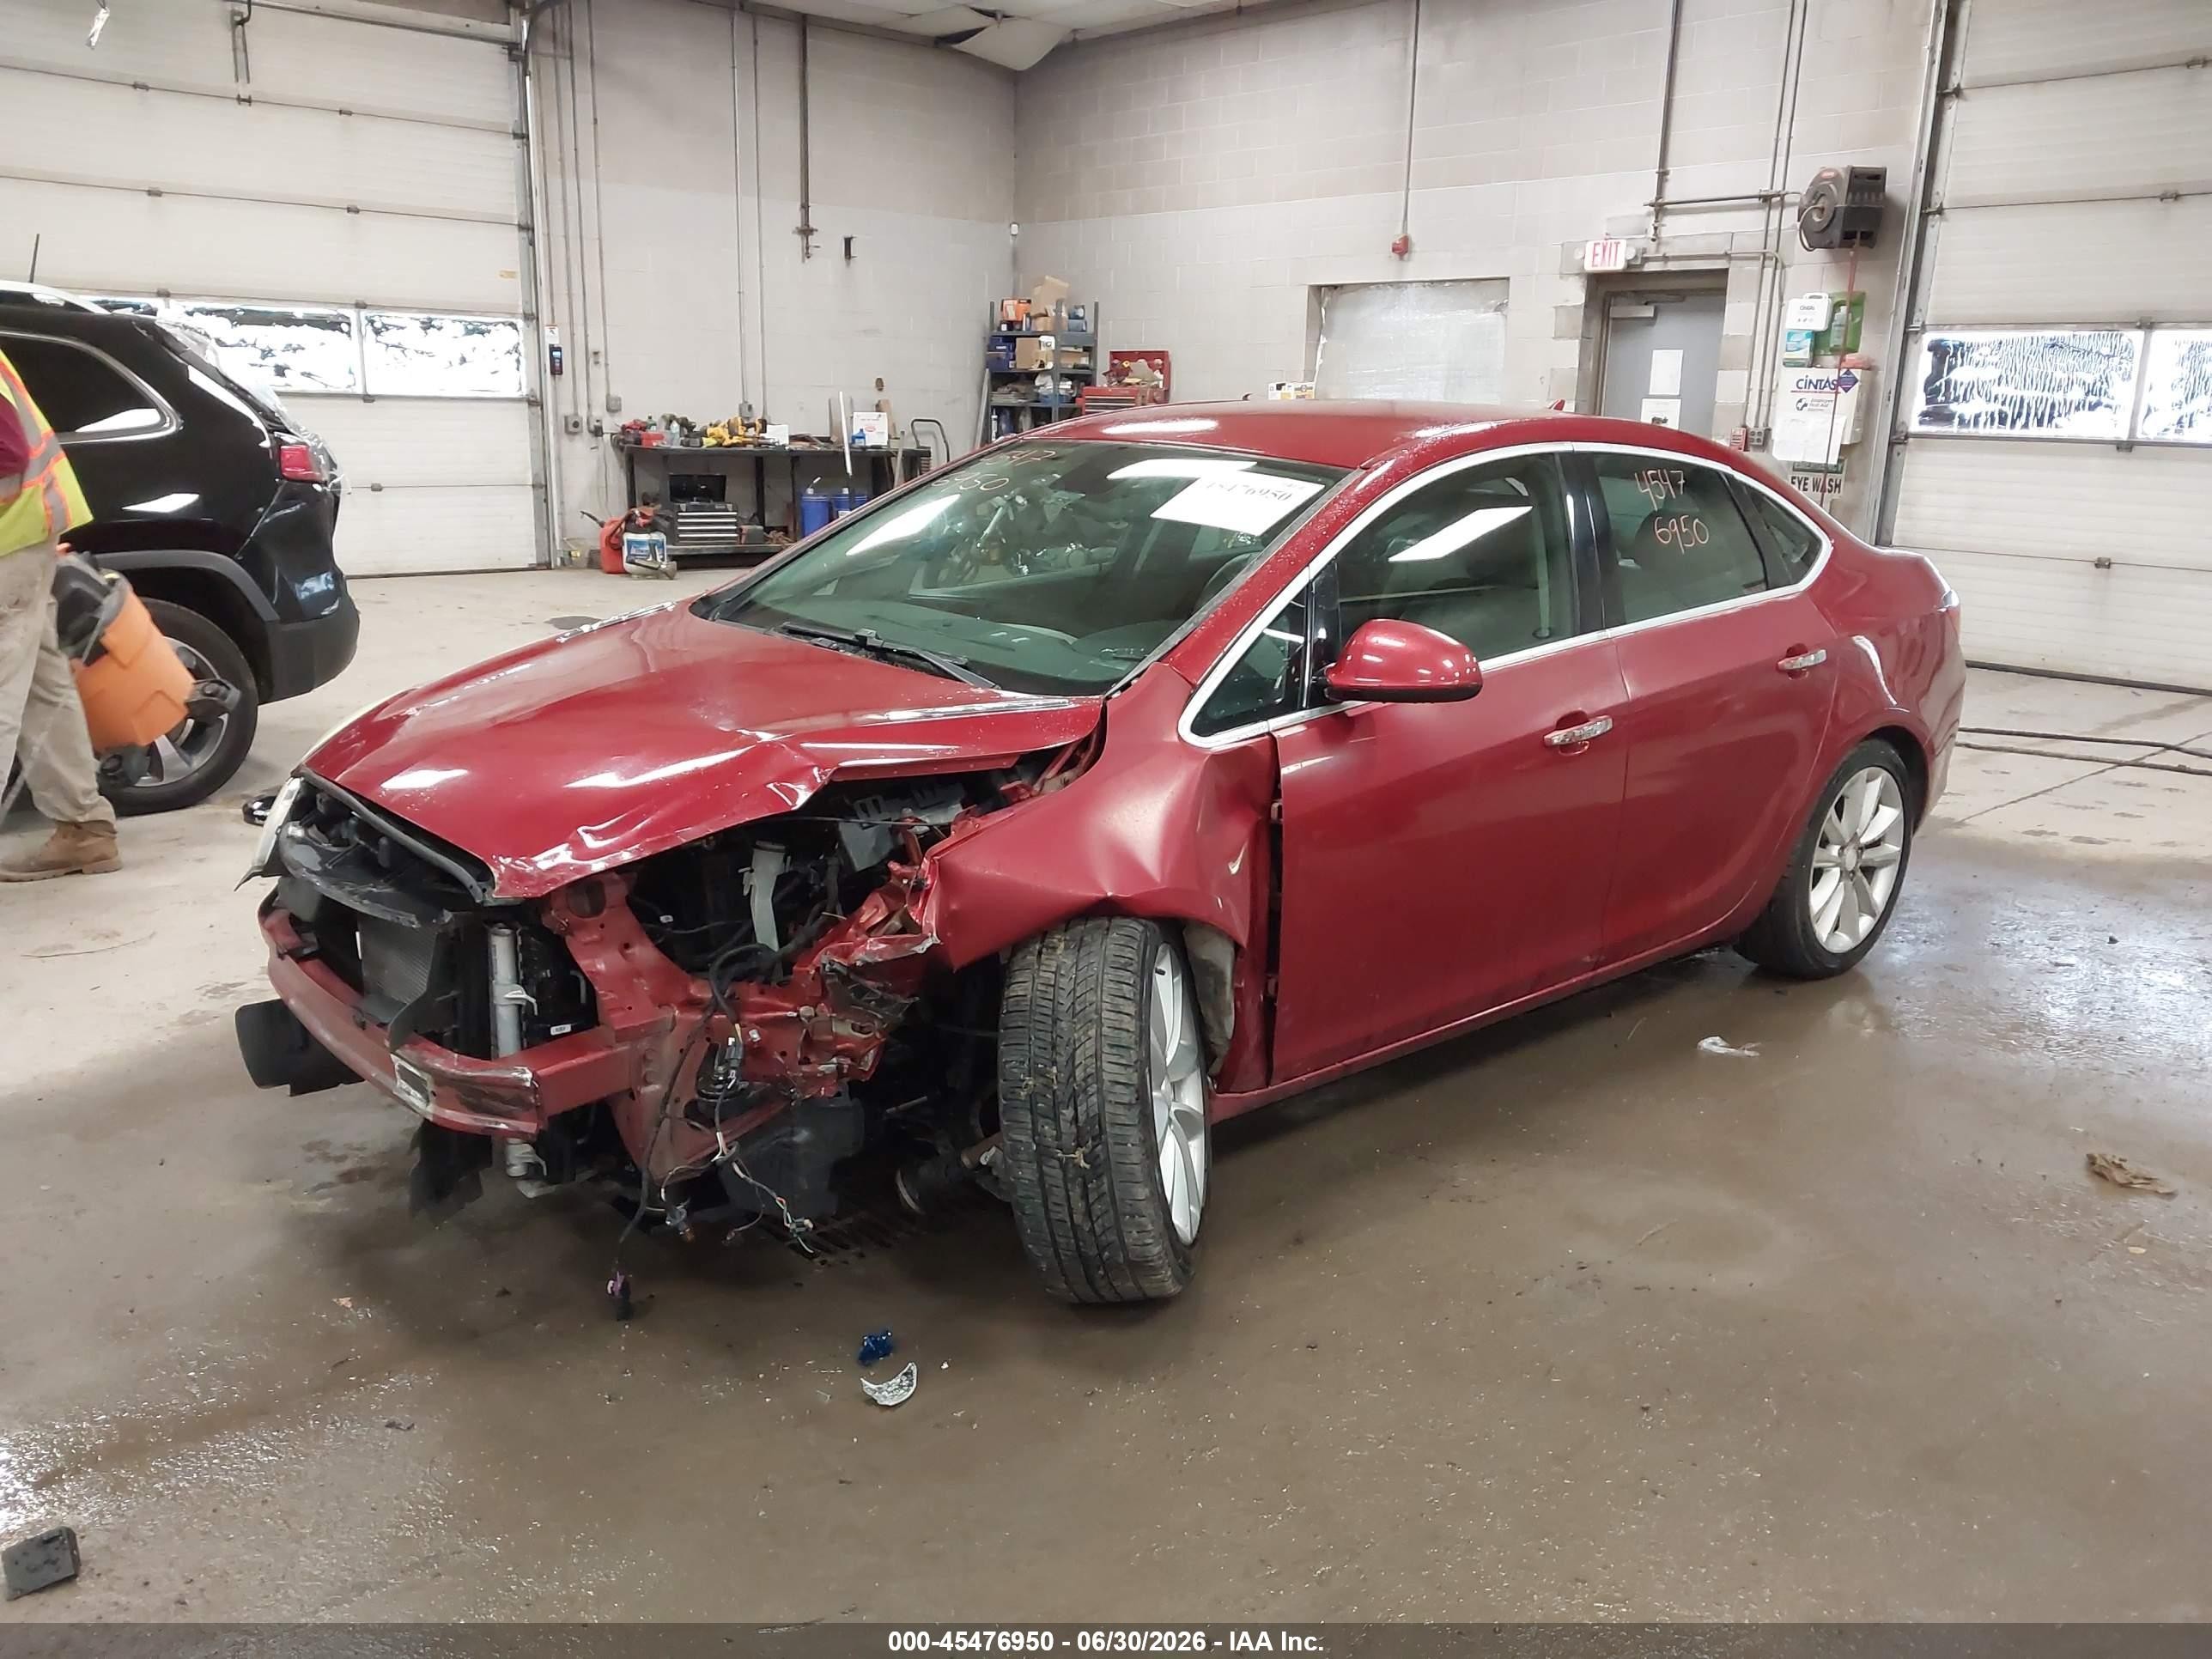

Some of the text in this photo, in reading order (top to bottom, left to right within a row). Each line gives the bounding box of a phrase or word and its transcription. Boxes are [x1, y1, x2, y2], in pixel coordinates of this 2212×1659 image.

[1592, 241, 1621, 268] EXIT
[1634, 469, 1686, 512] 4547
[1654, 515, 1710, 555] 6950
